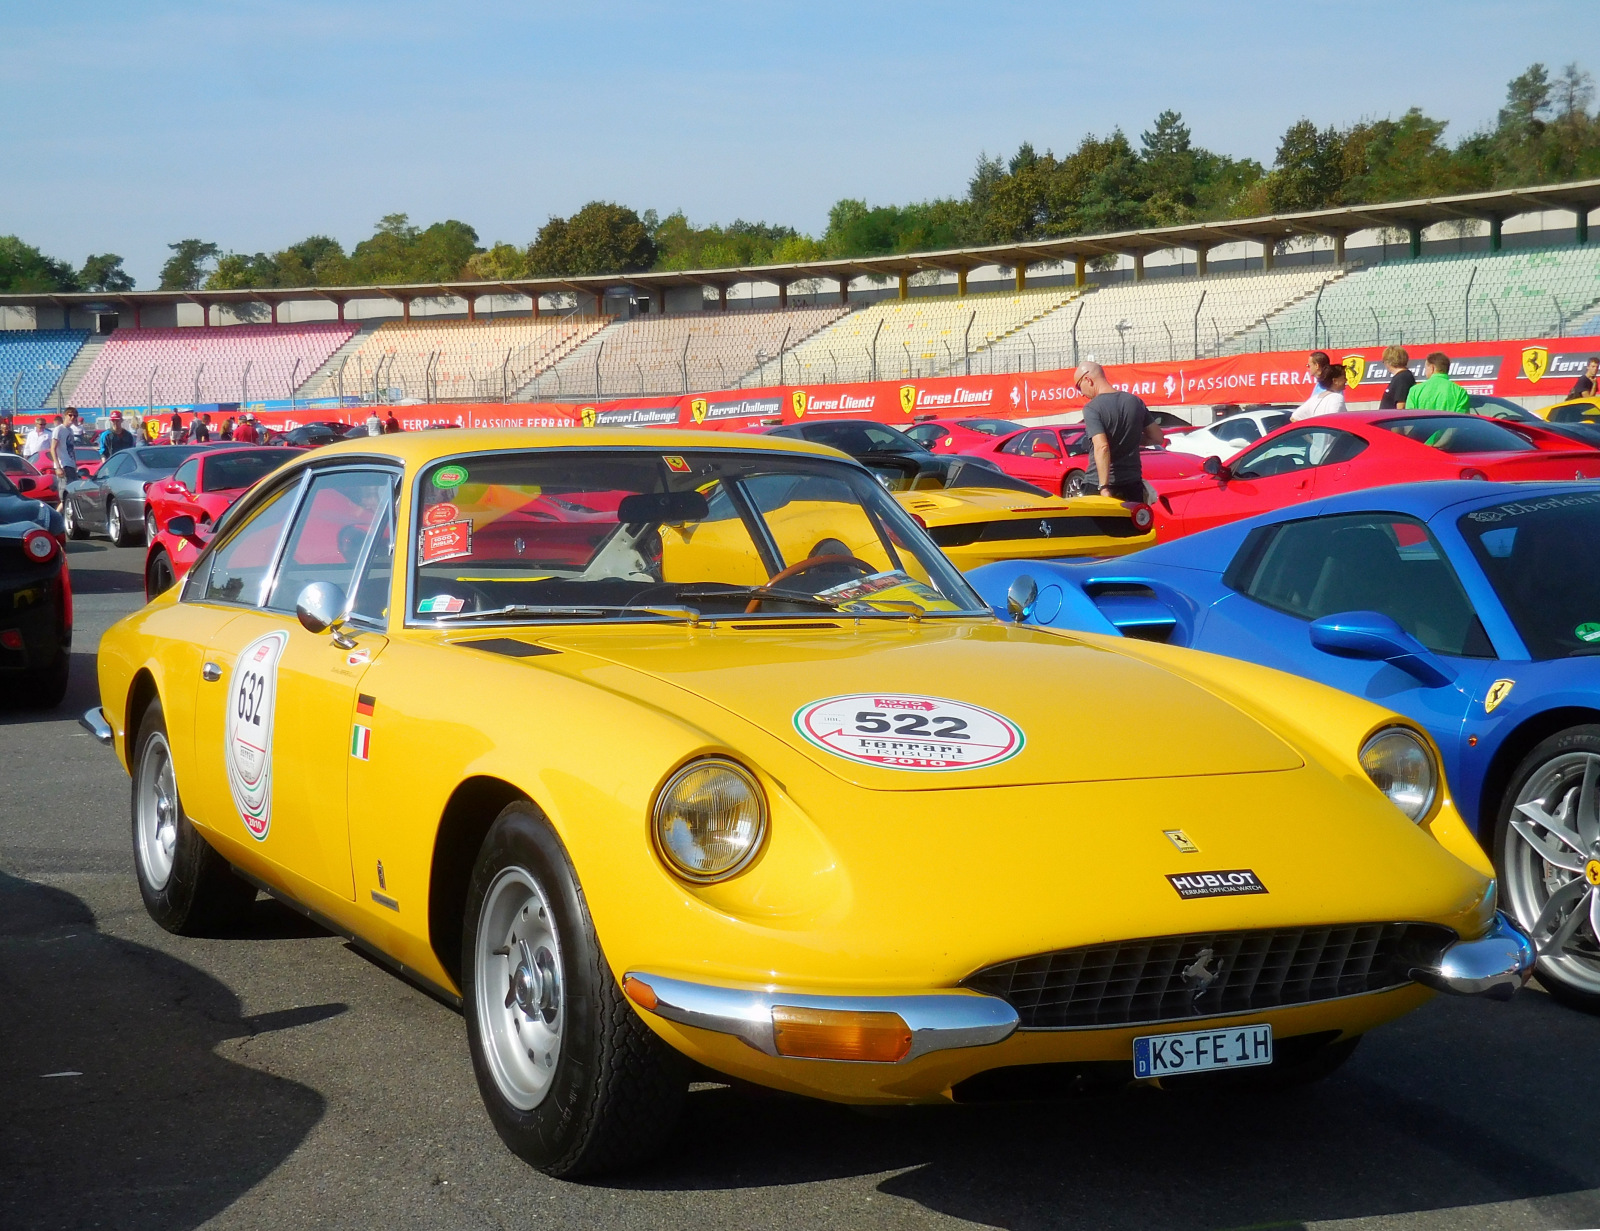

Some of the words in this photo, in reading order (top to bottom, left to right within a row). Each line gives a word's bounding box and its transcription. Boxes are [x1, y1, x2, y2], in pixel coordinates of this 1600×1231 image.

[1550, 356, 1588, 372] Ferr
[1188, 374, 1256, 391] PASSIONE
[1260, 370, 1317, 386] FERRA
[807, 396, 837, 410] Corse
[839, 394, 875, 409] Clienti
[917, 390, 951, 405] Corse
[953, 388, 993, 403] Clienti
[707, 404, 741, 416] Ferrari
[740, 401, 779, 414] Challenge
[475, 418, 524, 428] PASSIONE
[527, 417, 575, 427] FERRARI
[597, 412, 632, 424] Ferrari
[632, 411, 676, 423] Challenge
[238, 670, 264, 726] 632
[855, 711, 971, 740] 522
[858, 738, 964, 754] Ferrari
[882, 757, 947, 767] 2010
[1171, 872, 1255, 889] HUBLOT
[1181, 888, 1209, 896] FERRARI
[1209, 886, 1238, 894] OFFICIAL
[1139, 1060, 1146, 1073] D
[1152, 1034, 1228, 1070] KS-FE
[1235, 1030, 1269, 1061] 1H
